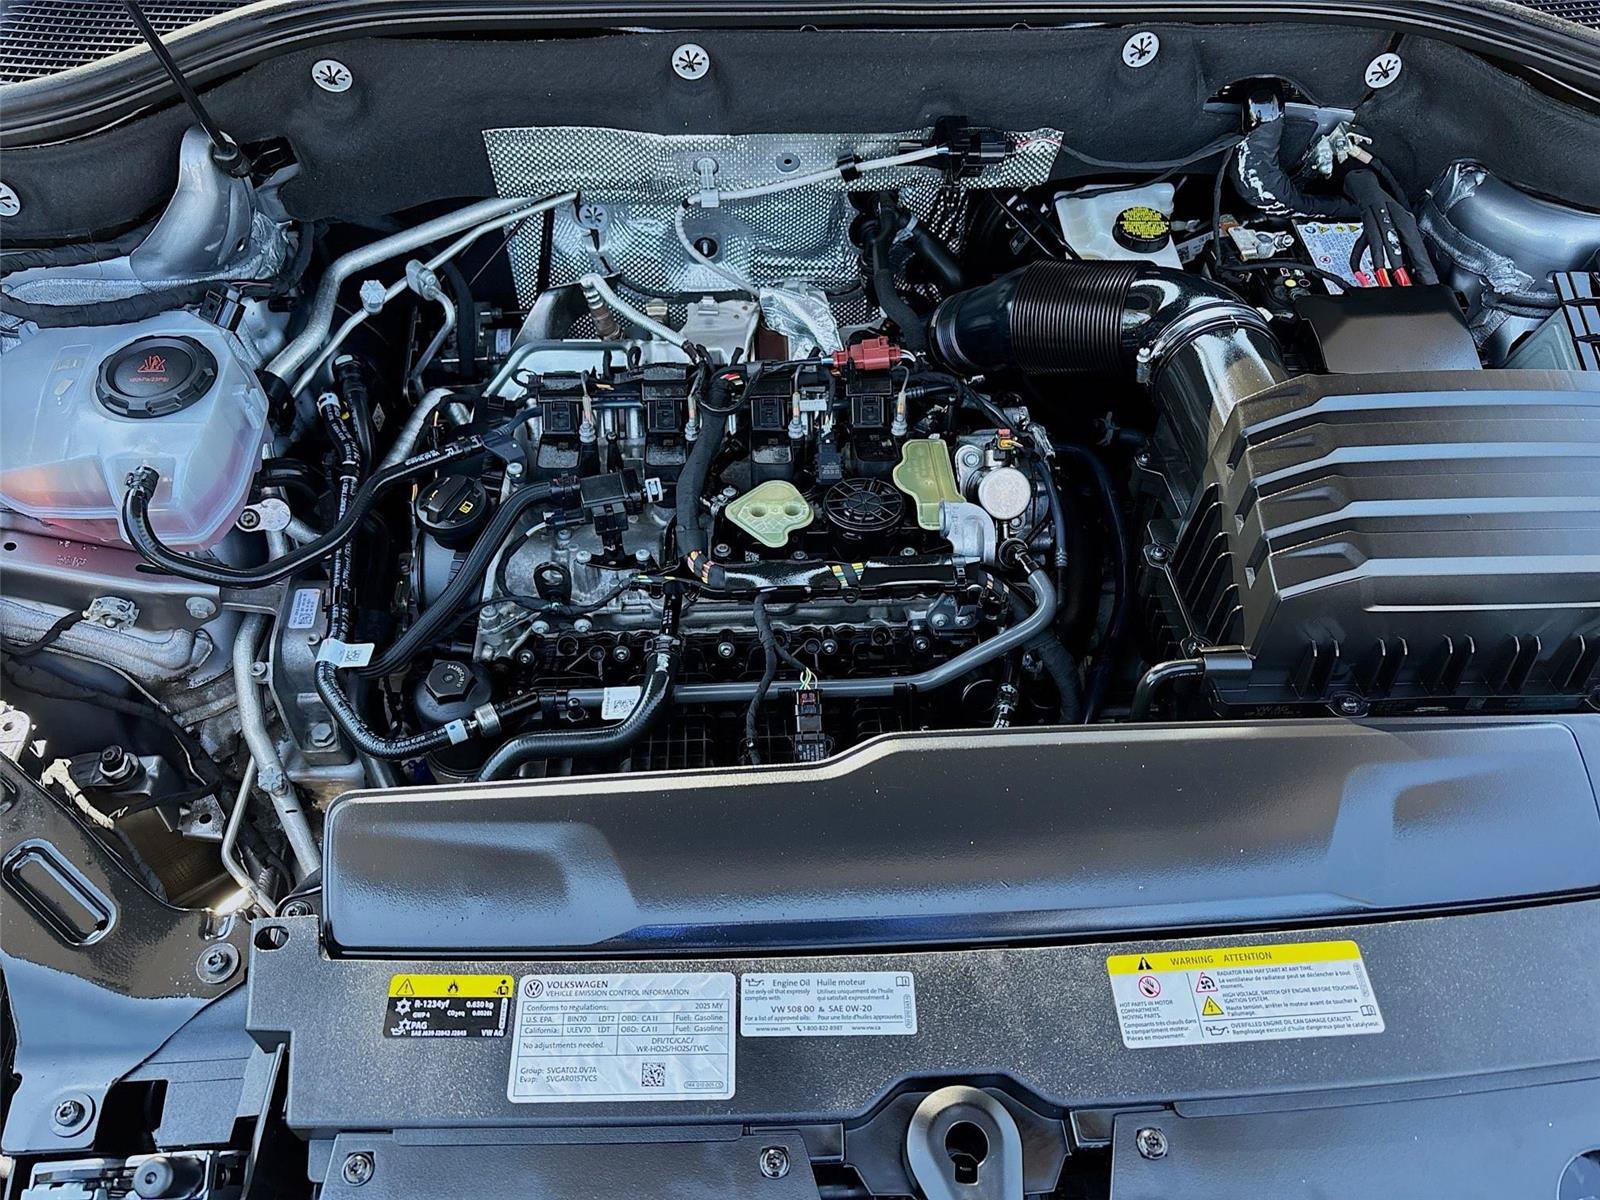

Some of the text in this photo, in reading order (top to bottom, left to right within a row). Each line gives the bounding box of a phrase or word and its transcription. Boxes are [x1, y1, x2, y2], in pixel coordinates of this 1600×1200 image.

[1170, 951, 1272, 966] WARNING ATTENTION
[547, 980, 608, 989] VOLKSWAGEN
[772, 978, 810, 988] Engine Oil
[838, 978, 866, 986] moteur
[642, 988, 690, 996] INFORMATION
[414, 1000, 450, 1010] R-1234yf
[485, 1001, 494, 1010] kg
[526, 1004, 559, 1012] Conforms
[695, 1002, 724, 1010] 2025 MY
[828, 1004, 844, 1012] SAE
[845, 1004, 872, 1012] 0W-20
[411, 1022, 428, 1030] PAG
[566, 1026, 592, 1034] ULEV70
[676, 1024, 724, 1032] Fuel: Gasoline
[534, 1042, 577, 1050] adjustments
[520, 1067, 544, 1076] Group:
